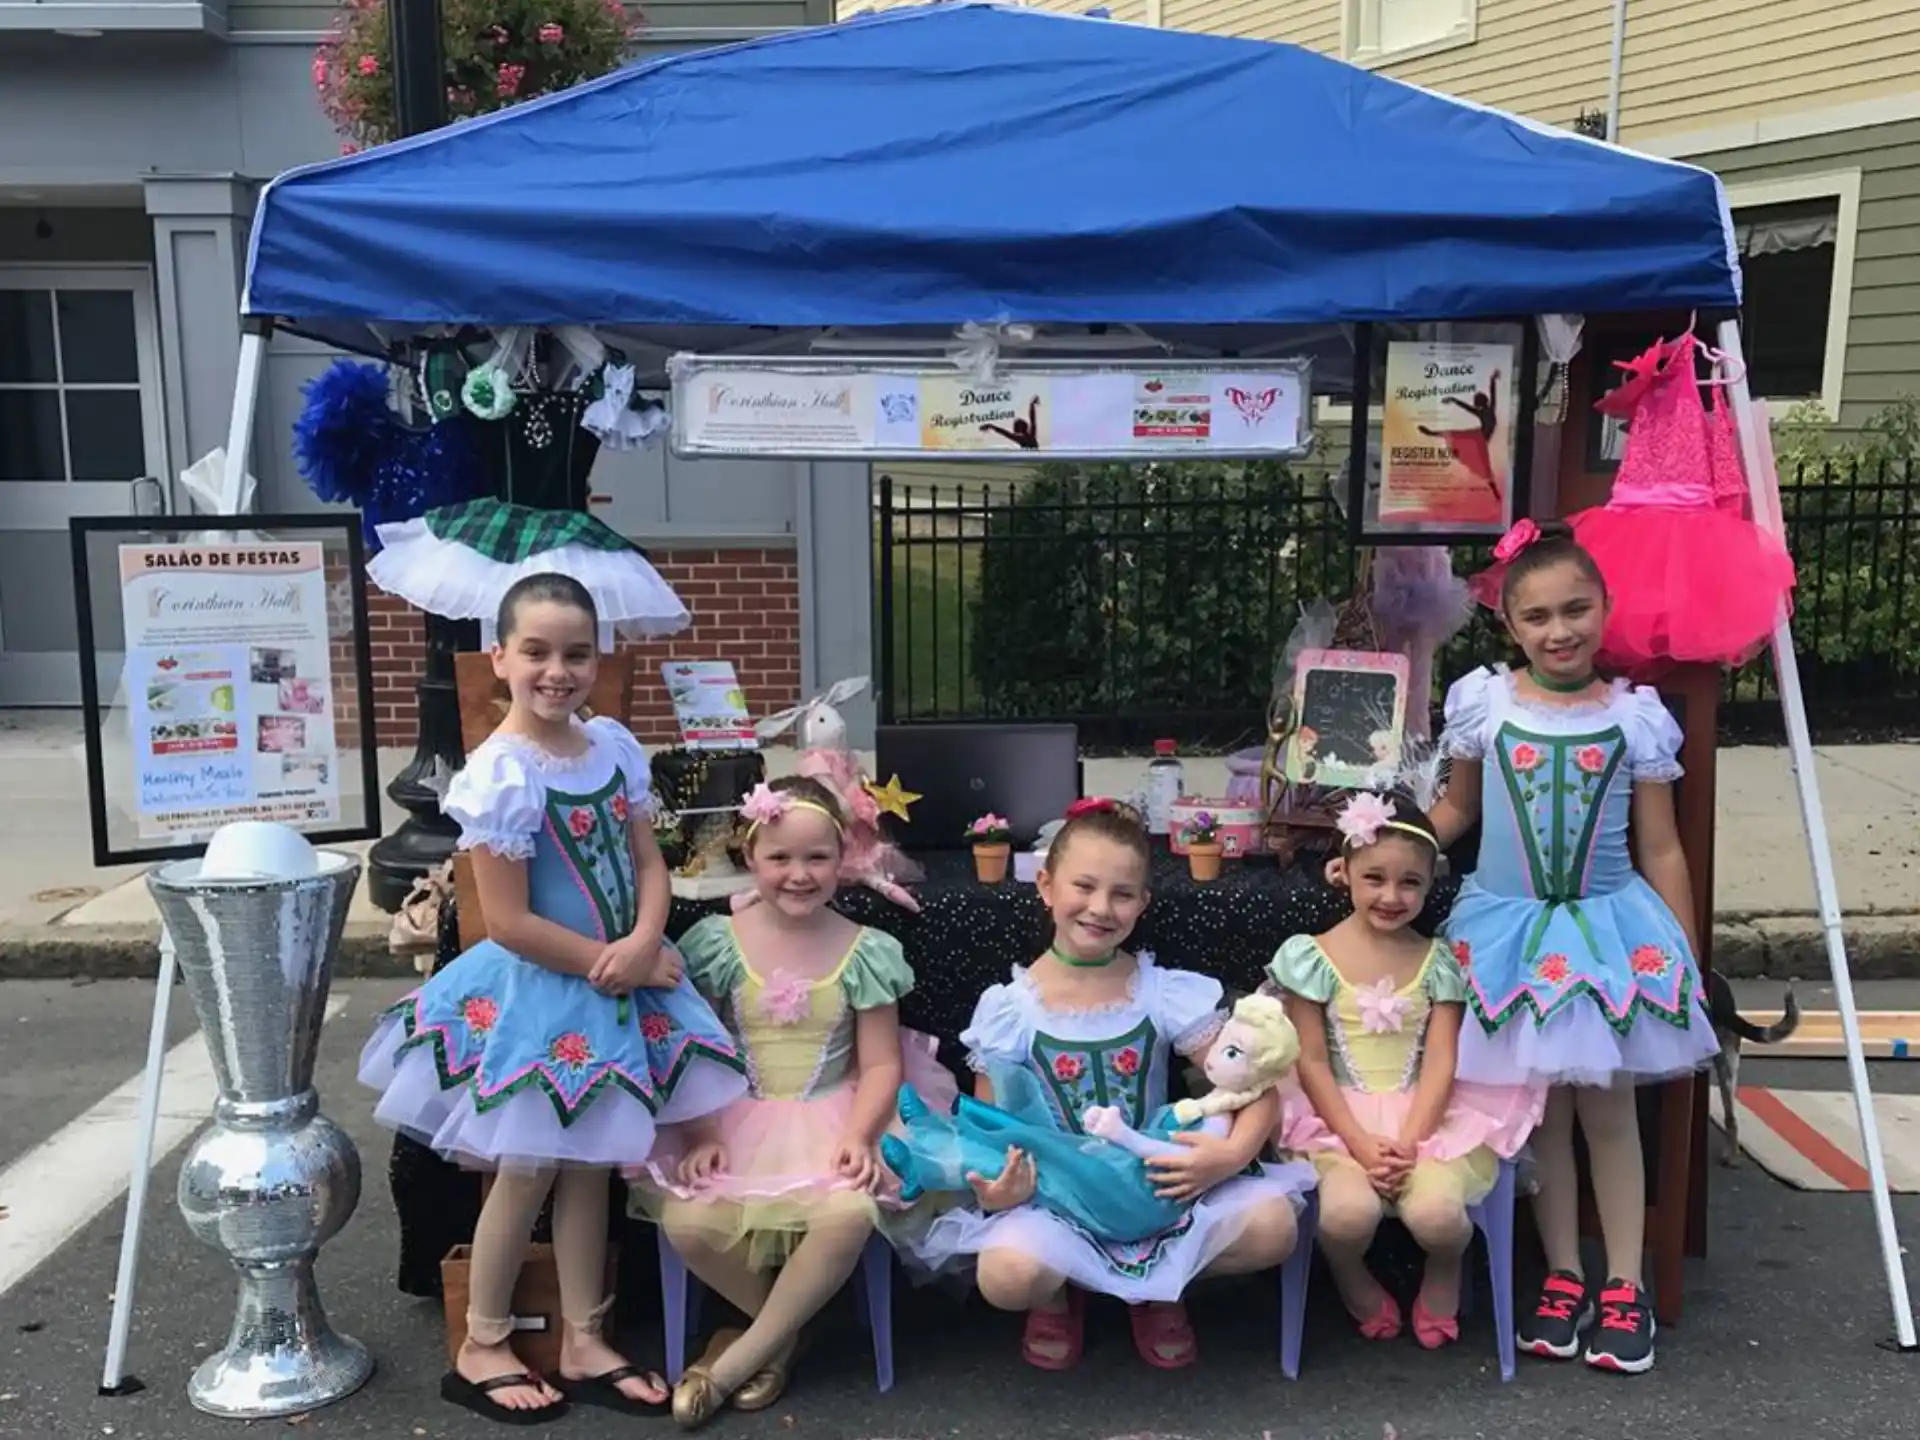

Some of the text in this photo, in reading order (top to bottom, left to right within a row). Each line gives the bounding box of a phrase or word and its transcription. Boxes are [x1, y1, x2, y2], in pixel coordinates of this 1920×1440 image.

[1424, 362, 1475, 379] Dance
[959, 389, 1012, 407] Dance
[1395, 383, 1477, 402] Registration
[930, 408, 1017, 429] Registration
[1391, 447, 1435, 459] REGISTER
[209, 551, 231, 567] DE
[237, 550, 301, 567] FESTAS
